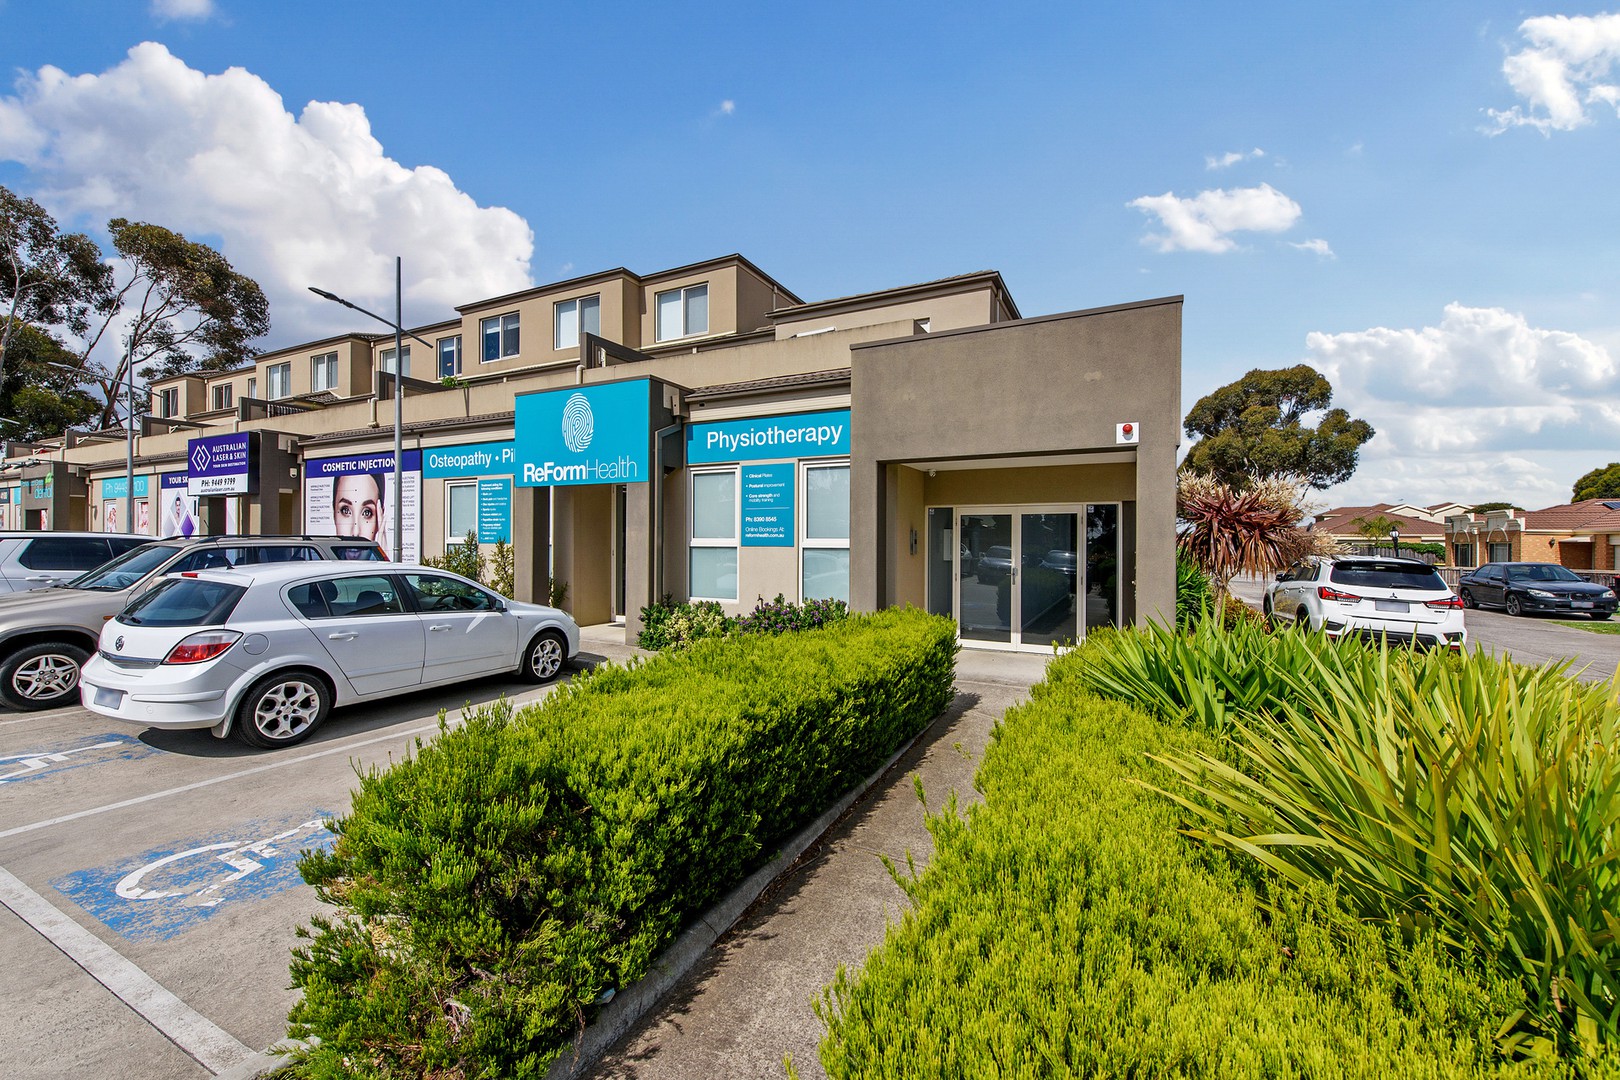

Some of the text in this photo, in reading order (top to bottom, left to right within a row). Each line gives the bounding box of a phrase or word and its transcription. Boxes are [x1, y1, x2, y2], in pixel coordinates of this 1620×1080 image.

[707, 425, 843, 452] Physiotherapy
[212, 442, 247, 453] AUSTRALIAN
[212, 453, 229, 462] LASER
[233, 451, 247, 459] SKIN
[429, 450, 492, 469] Osteopathy
[322, 461, 357, 472] COSMETIC
[523, 455, 638, 483] ReFormHealth
[168, 476, 182, 485] YOUR
[201, 479, 211, 487] PH:
